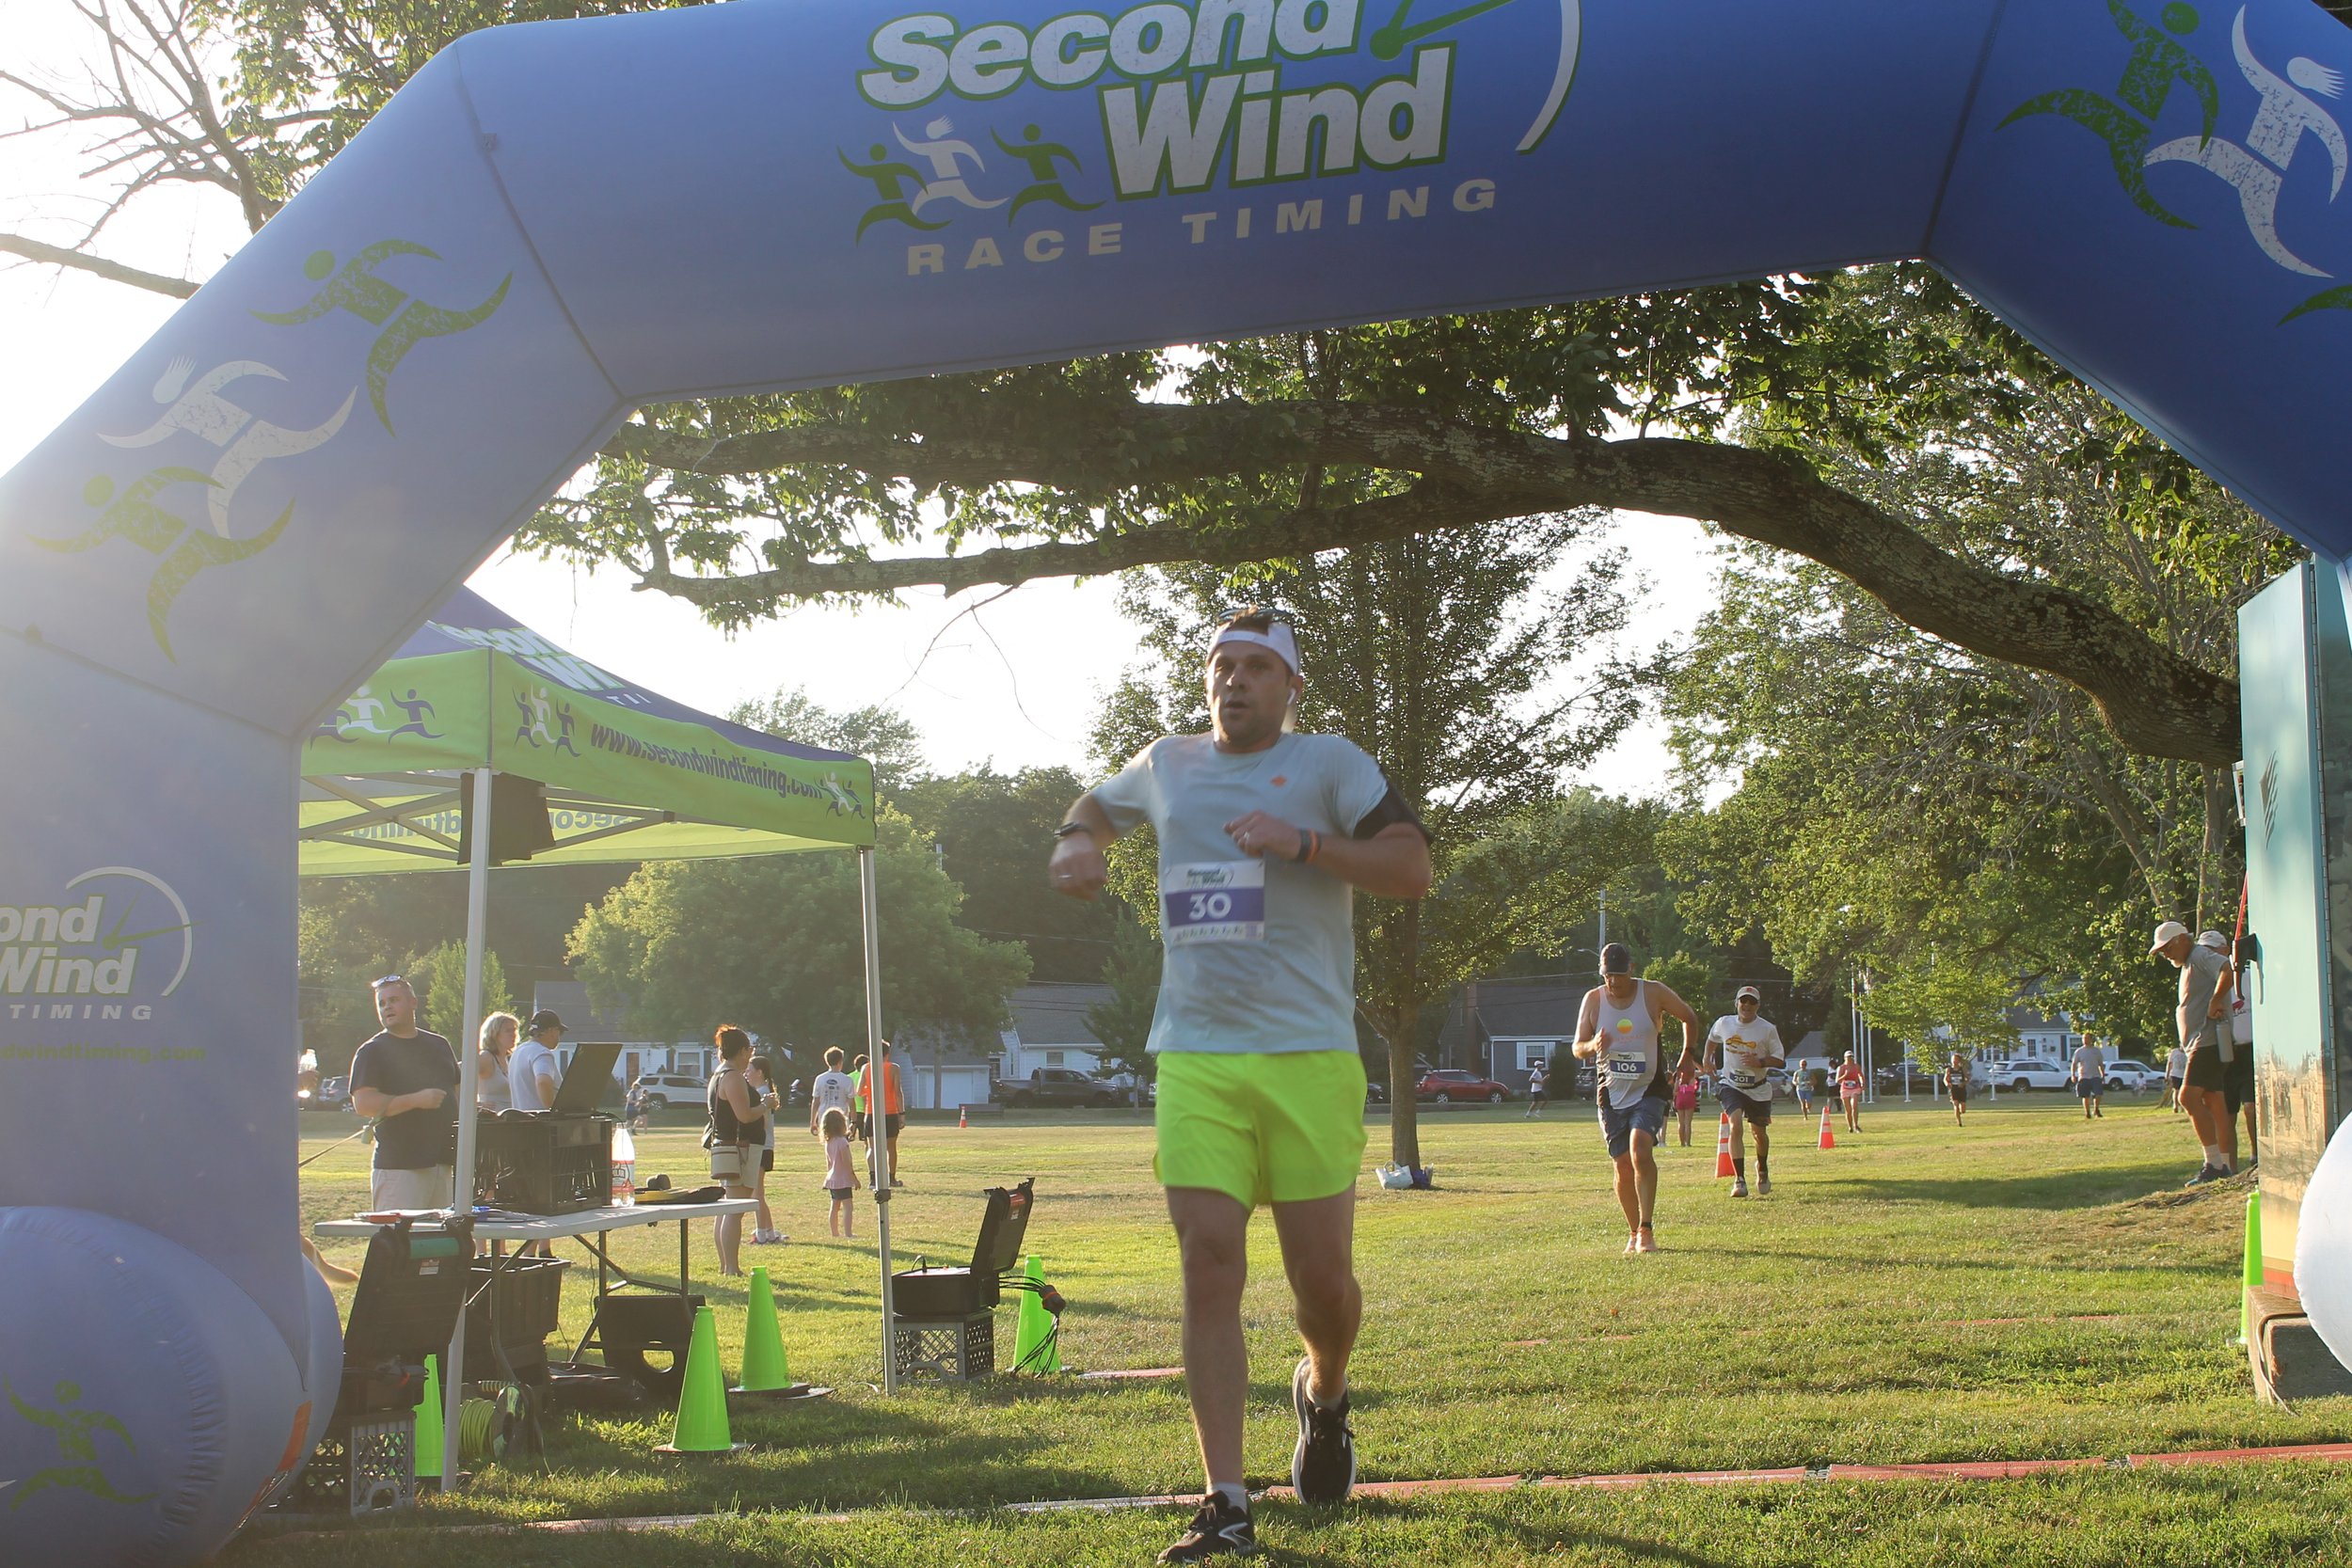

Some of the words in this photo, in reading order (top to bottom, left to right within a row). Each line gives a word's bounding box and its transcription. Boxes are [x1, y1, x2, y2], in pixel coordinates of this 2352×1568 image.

[857, 0, 1363, 110] Second
[1098, 42, 1454, 199] Wind
[907, 223, 1123, 276] RACE
[1182, 178, 1497, 245] TIMING
[590, 722, 824, 800] www.secondwindtiming.com
[1189, 893, 1232, 920] 30
[9, 1004, 152, 1021] TIMING
[1616, 1062, 1637, 1072] 106
